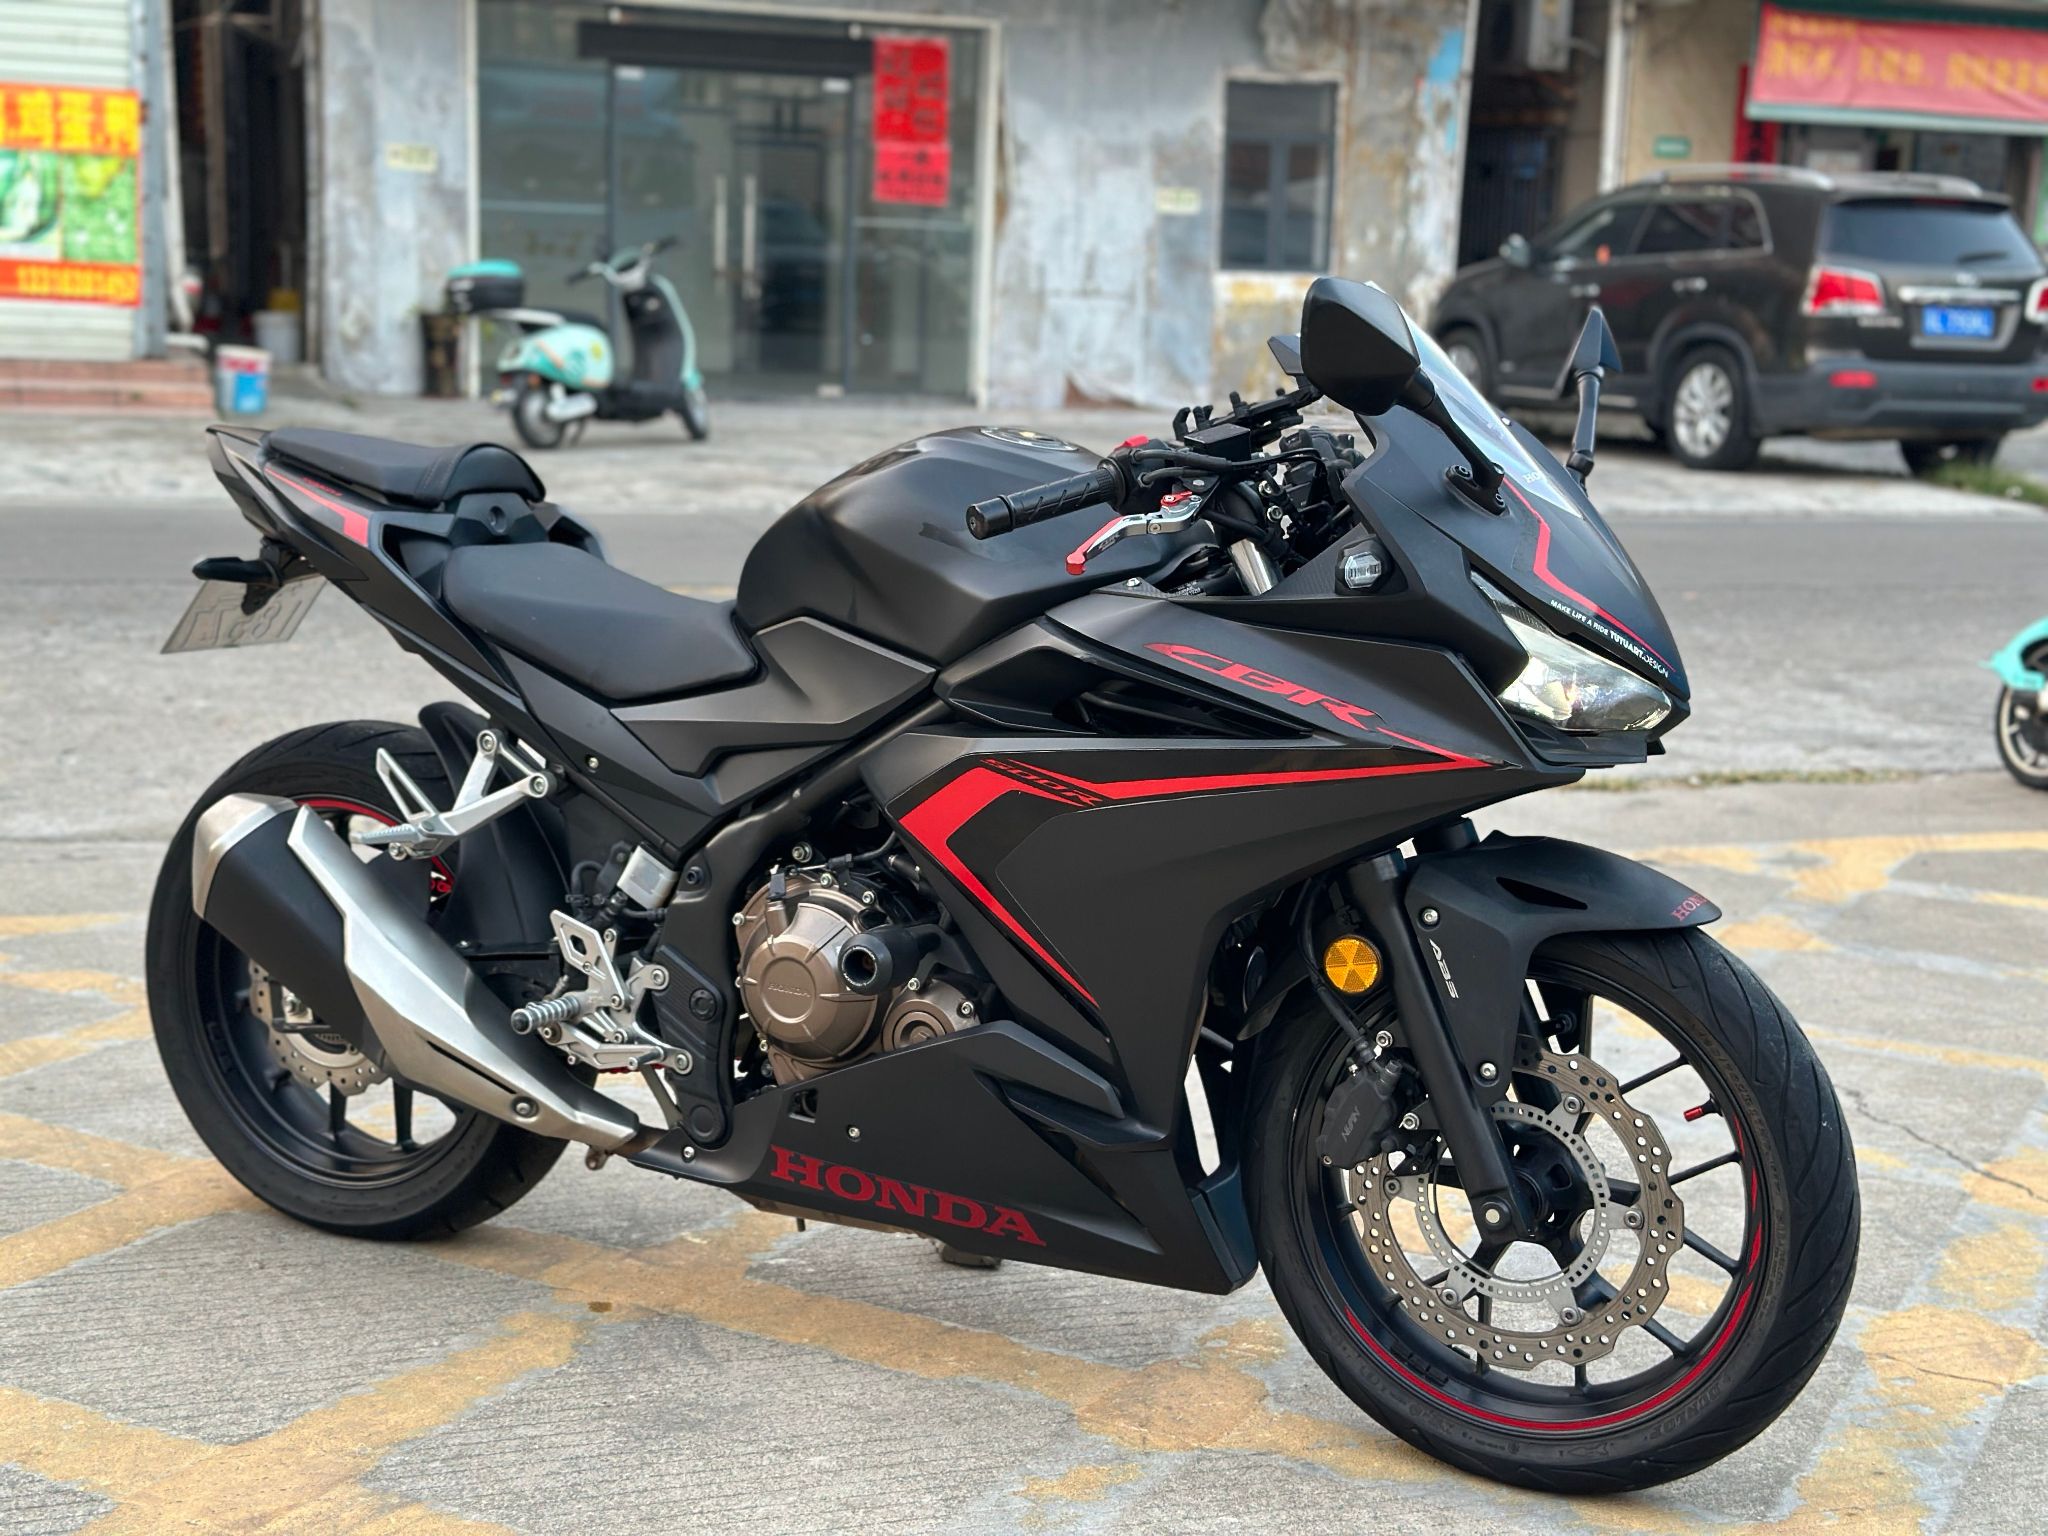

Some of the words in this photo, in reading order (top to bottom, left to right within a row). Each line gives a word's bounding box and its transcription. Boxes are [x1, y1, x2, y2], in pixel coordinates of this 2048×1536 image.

[1550, 599, 1571, 615] MAKE
[1572, 610, 1587, 623] LIFE
[1594, 622, 1610, 636] RIDE
[1143, 642, 1377, 732] CBR
[1428, 938, 1460, 999] ABS
[769, 1143, 1048, 1248] HONDA
